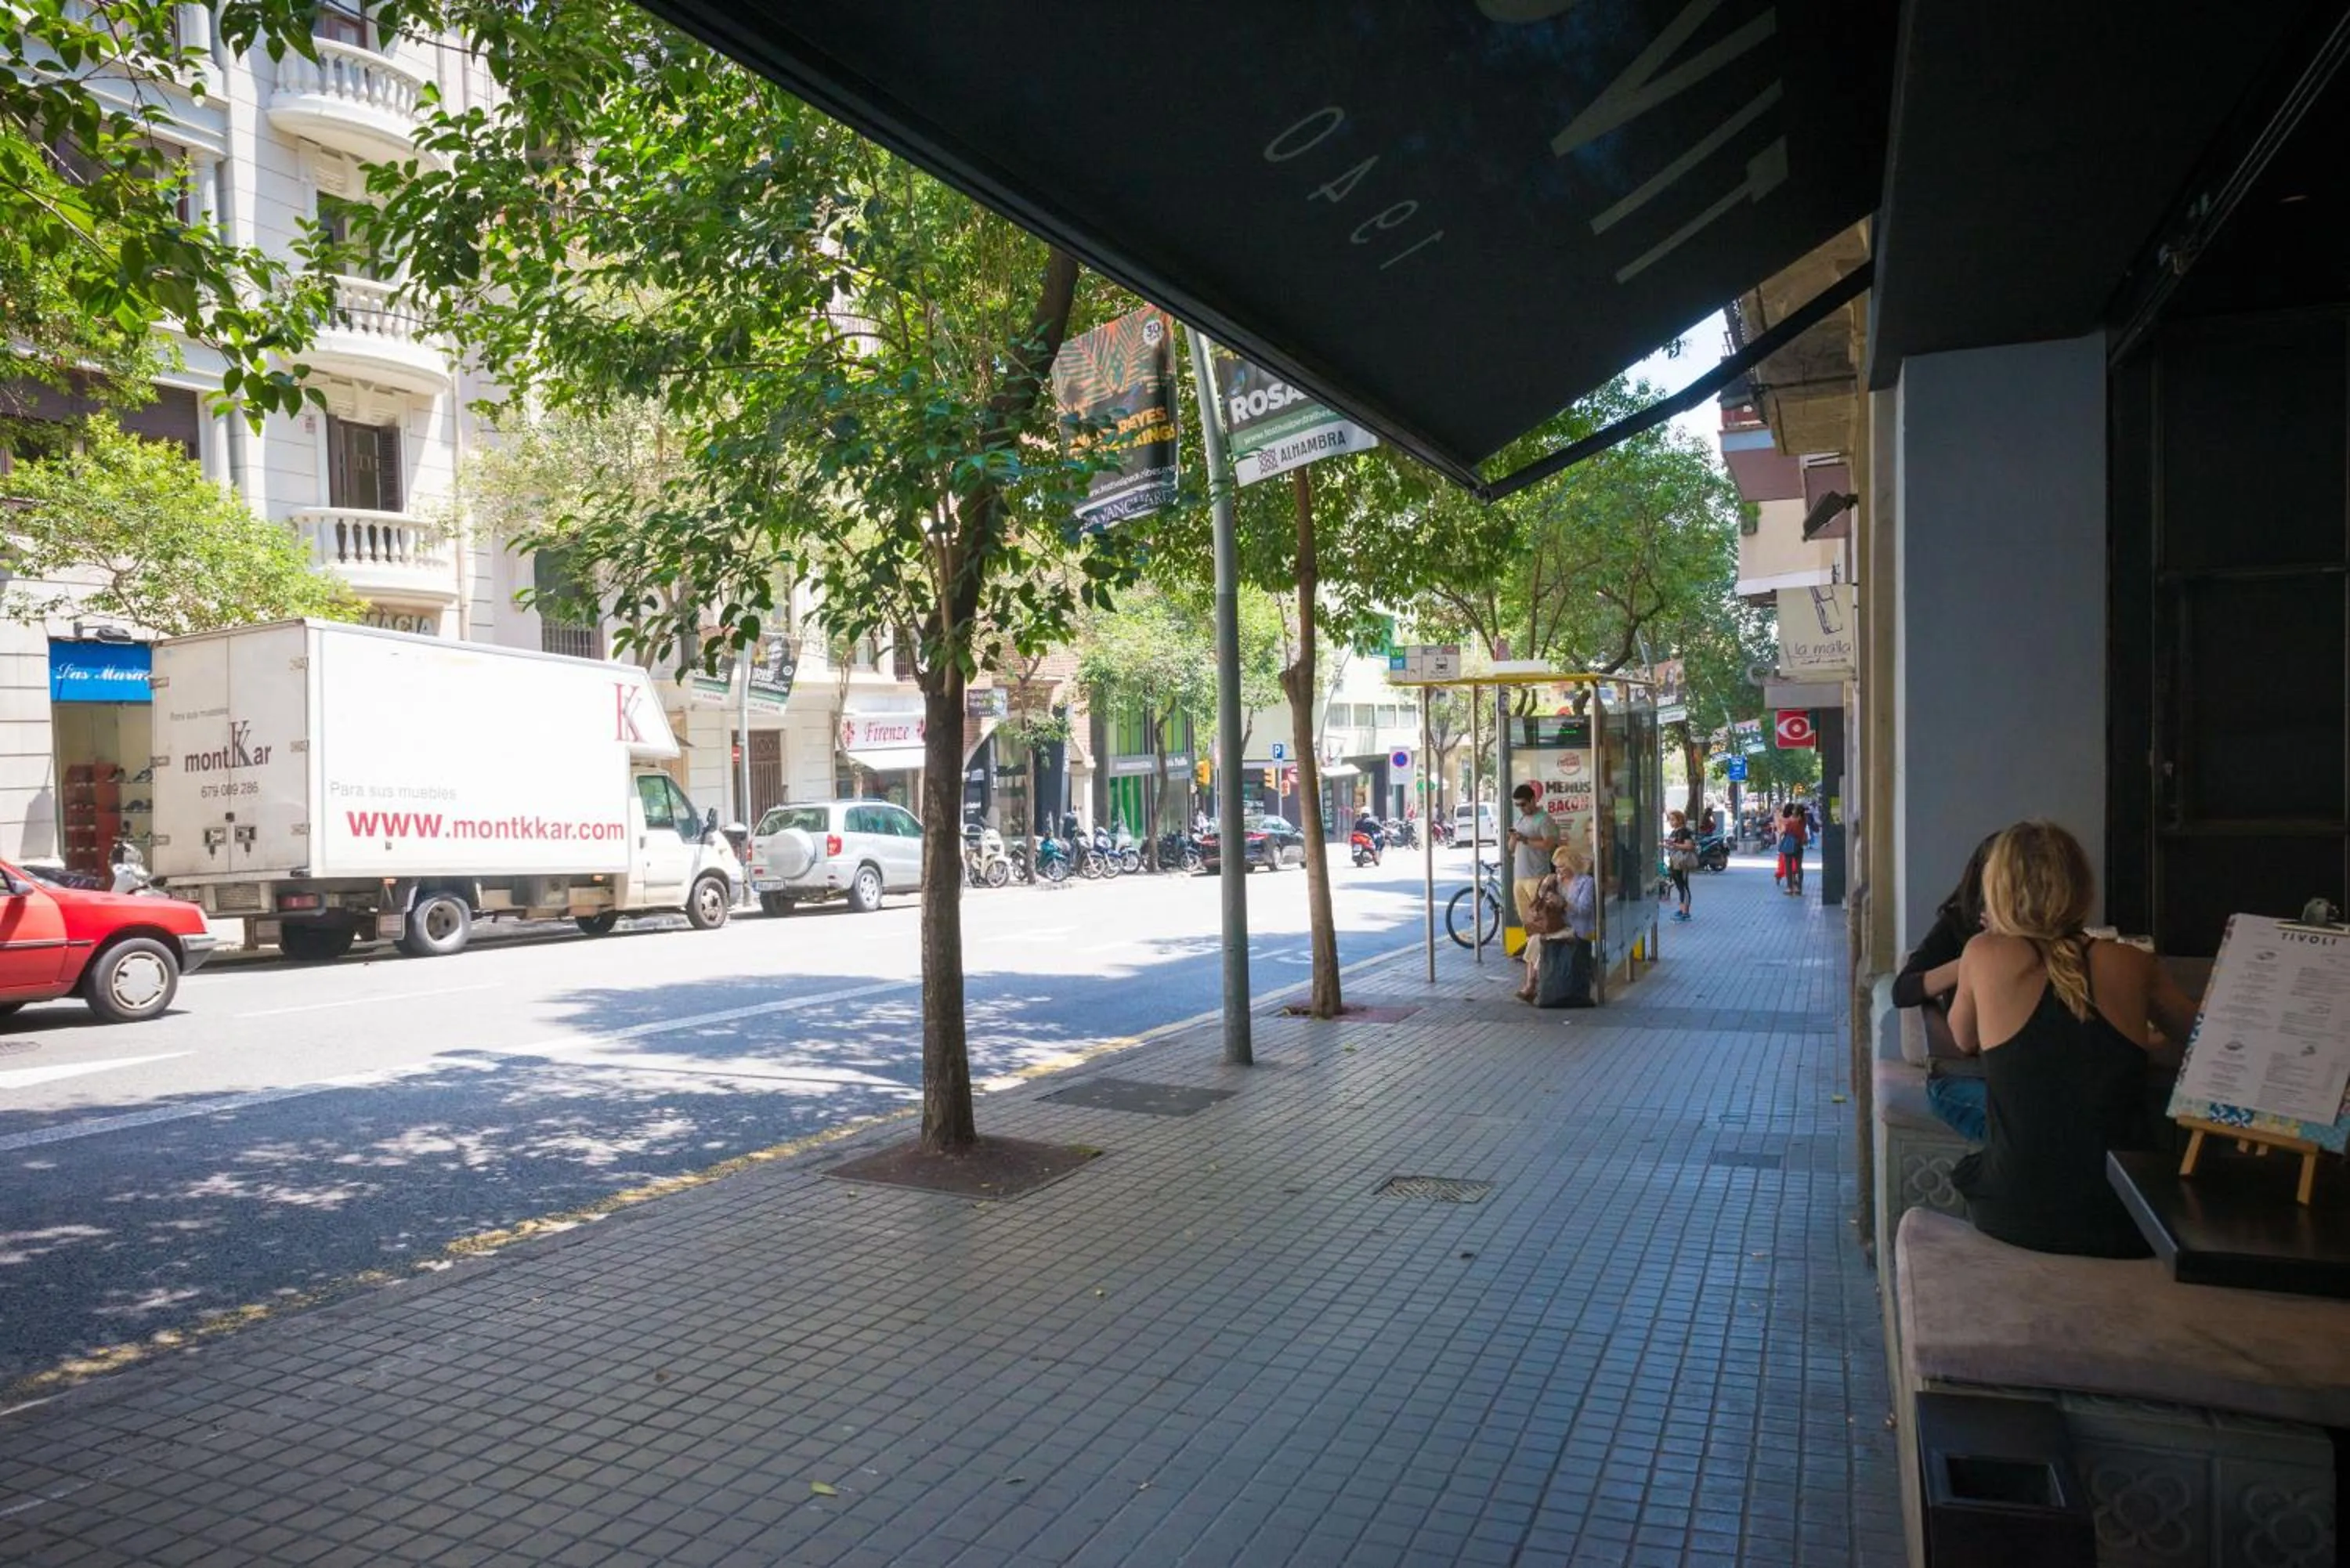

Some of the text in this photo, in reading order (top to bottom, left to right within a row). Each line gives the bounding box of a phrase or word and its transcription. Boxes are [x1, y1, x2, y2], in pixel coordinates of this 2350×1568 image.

[1280, 430, 1347, 463] ALHAMBRA
[864, 721, 909, 742] Firenze
[329, 780, 457, 801] Para sus muebles
[2281, 931, 2338, 947] TIVOLI
